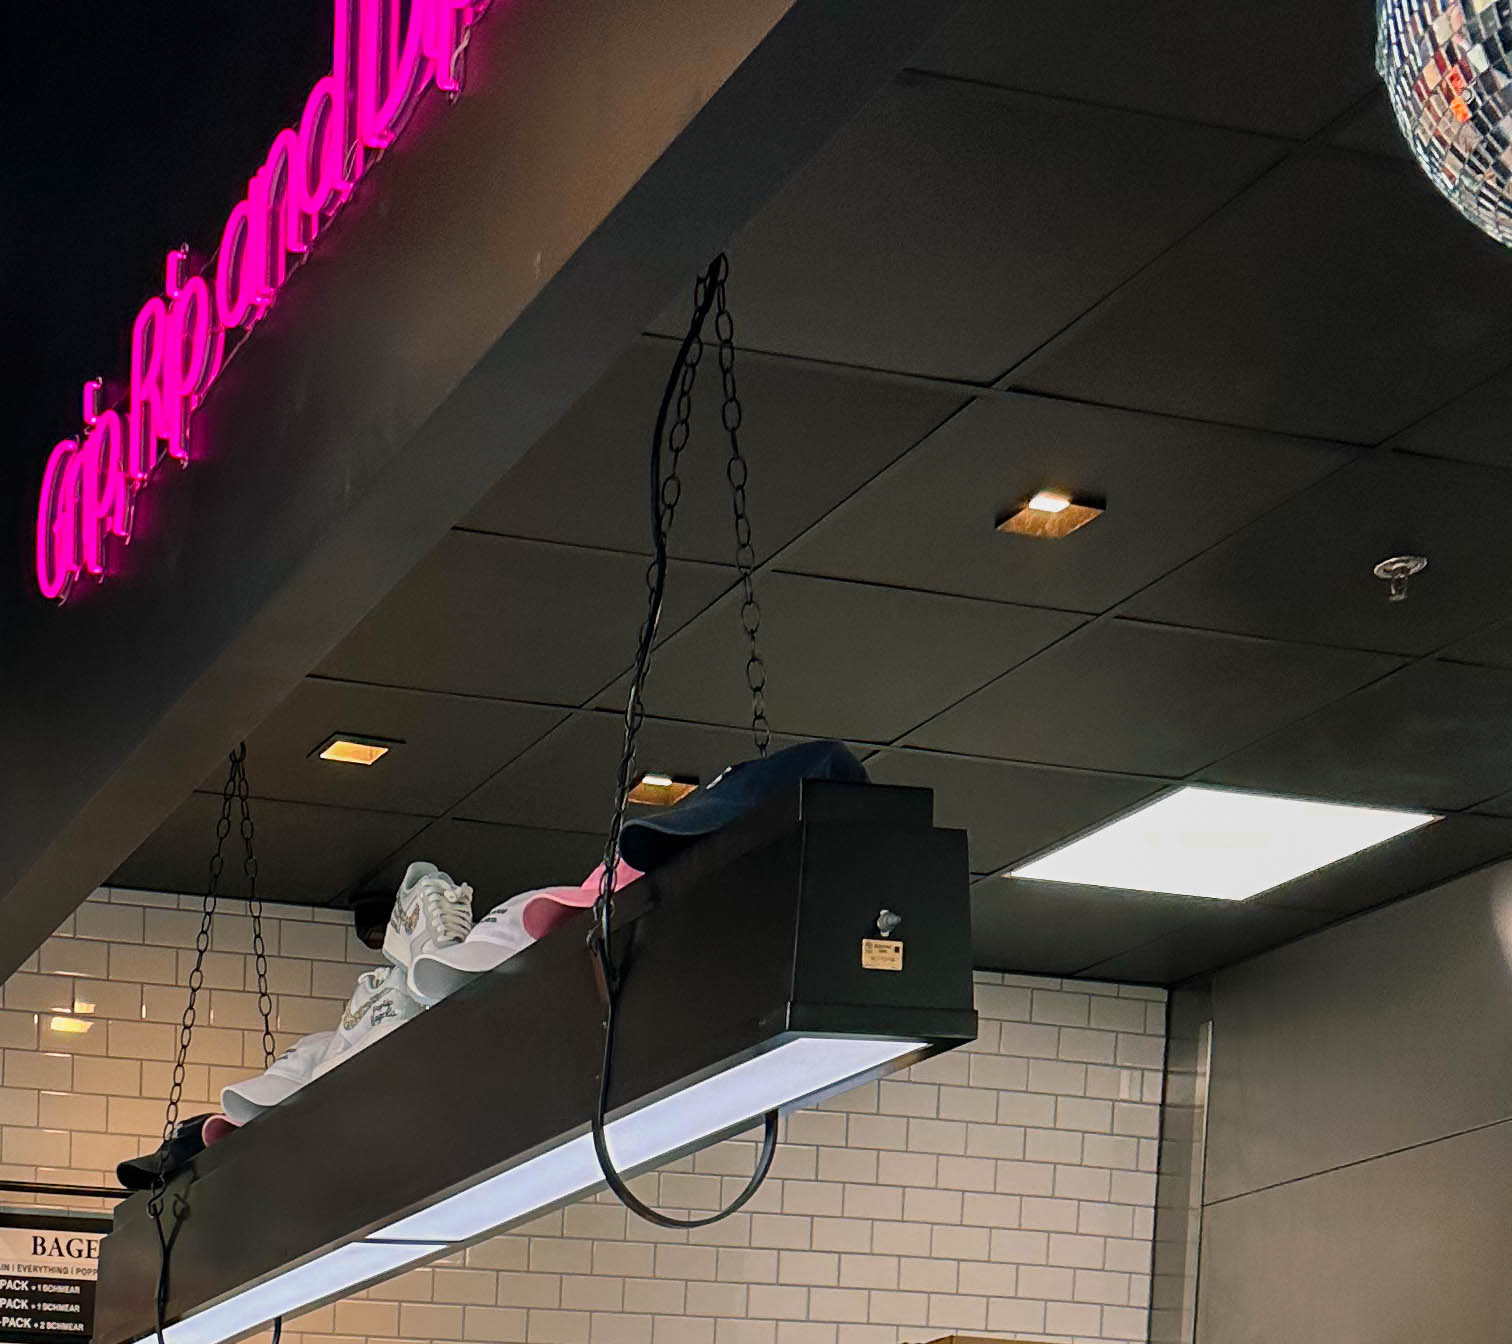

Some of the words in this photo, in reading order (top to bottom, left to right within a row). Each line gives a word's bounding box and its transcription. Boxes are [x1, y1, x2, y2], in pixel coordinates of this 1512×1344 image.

[31, 1235, 100, 1259] BAGE
[17, 1264, 68, 1274] EVERYTHING
[76, 1268, 99, 1276] POPP
